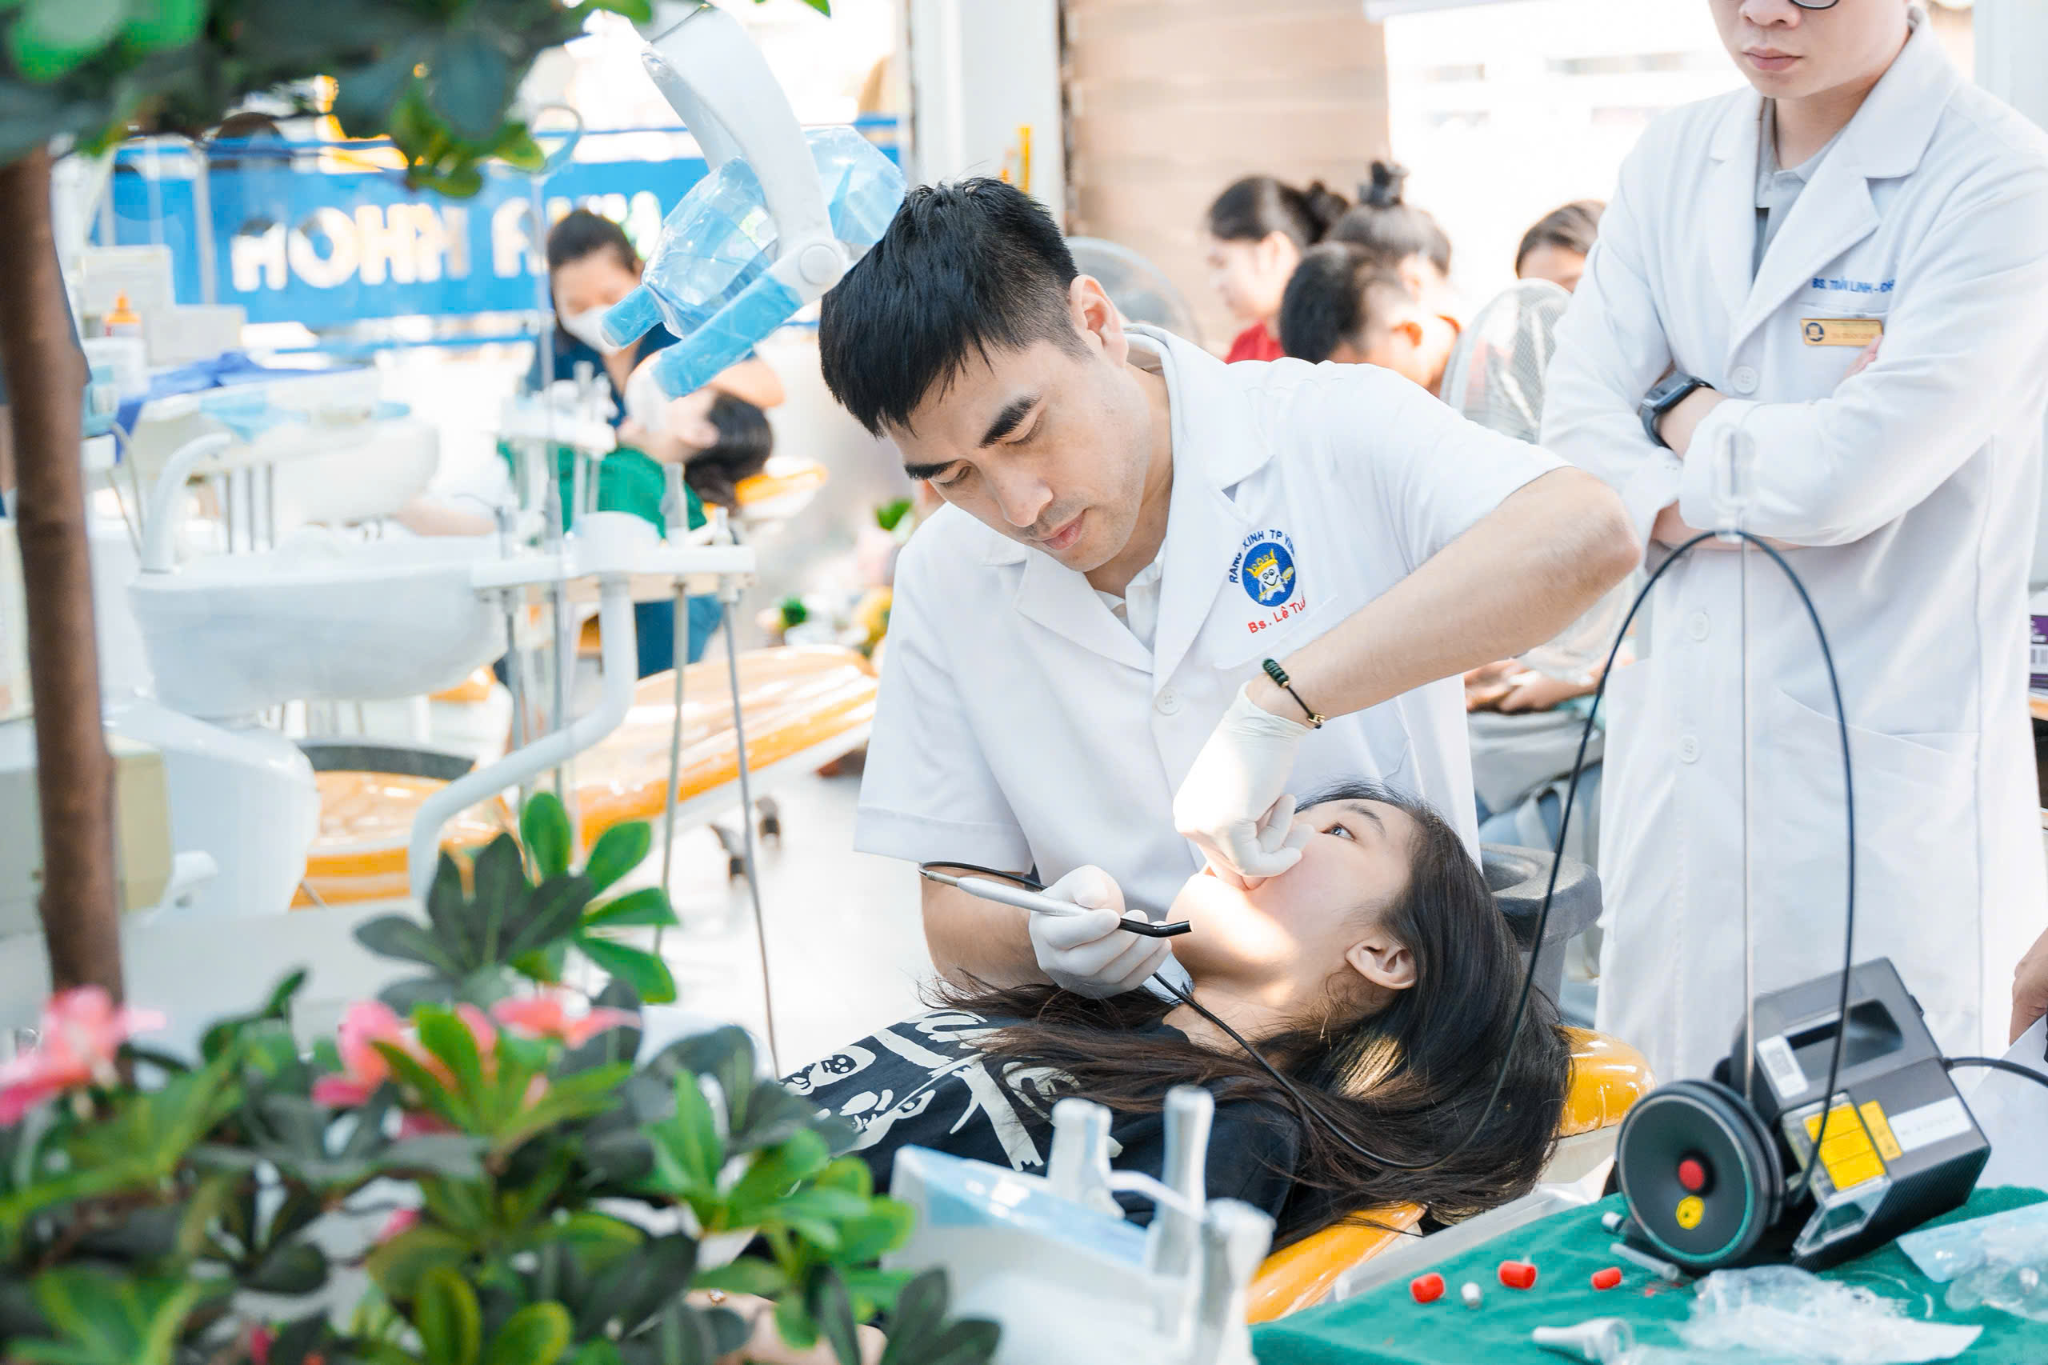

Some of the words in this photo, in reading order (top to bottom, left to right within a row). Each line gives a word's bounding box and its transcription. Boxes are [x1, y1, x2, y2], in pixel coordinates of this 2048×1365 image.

[1242, 530, 1265, 549] XINH
[1269, 529, 1283, 540] TP
[1247, 620, 1272, 633] Bs.
[1289, 597, 1306, 614] Tu
